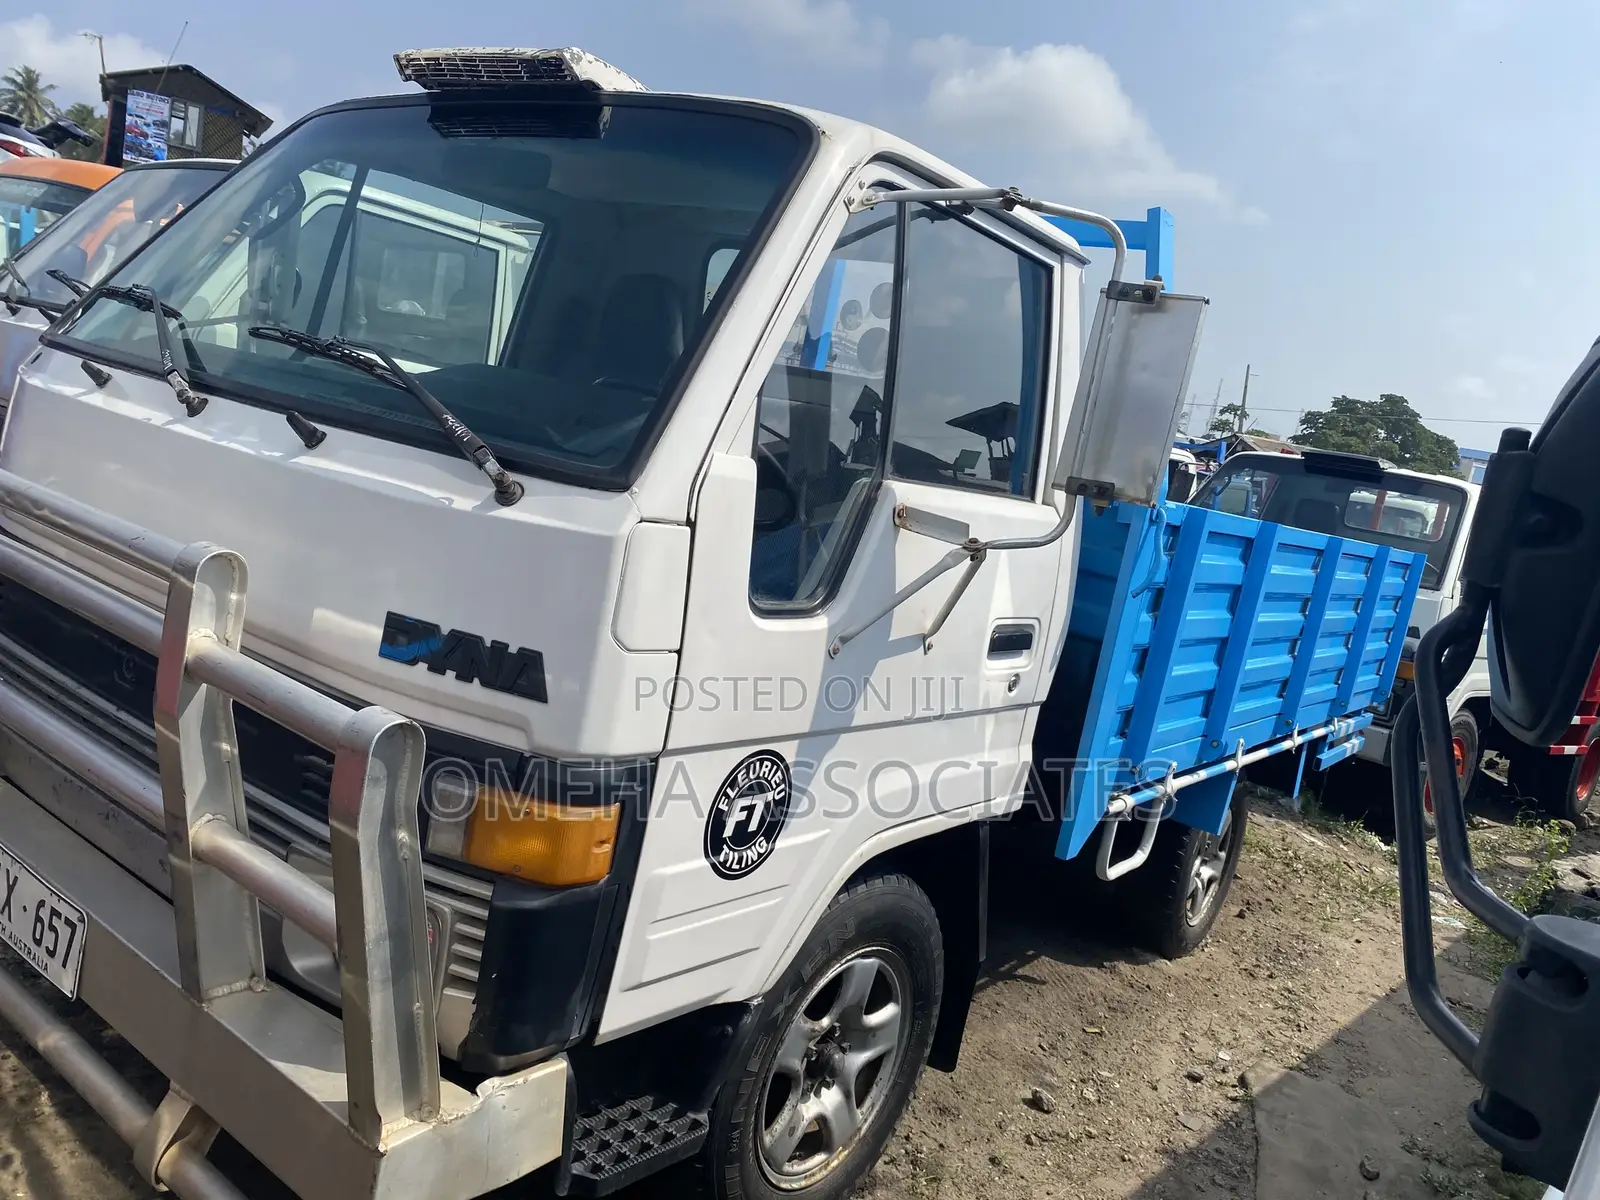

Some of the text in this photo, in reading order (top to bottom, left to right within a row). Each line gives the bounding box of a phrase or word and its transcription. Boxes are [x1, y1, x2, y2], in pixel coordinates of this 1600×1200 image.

[379, 611, 548, 703] DYNA
[718, 761, 785, 811] FLEURIEU
[720, 836, 768, 869] TILING
[8, 930, 49, 975] AUSTRALIA
